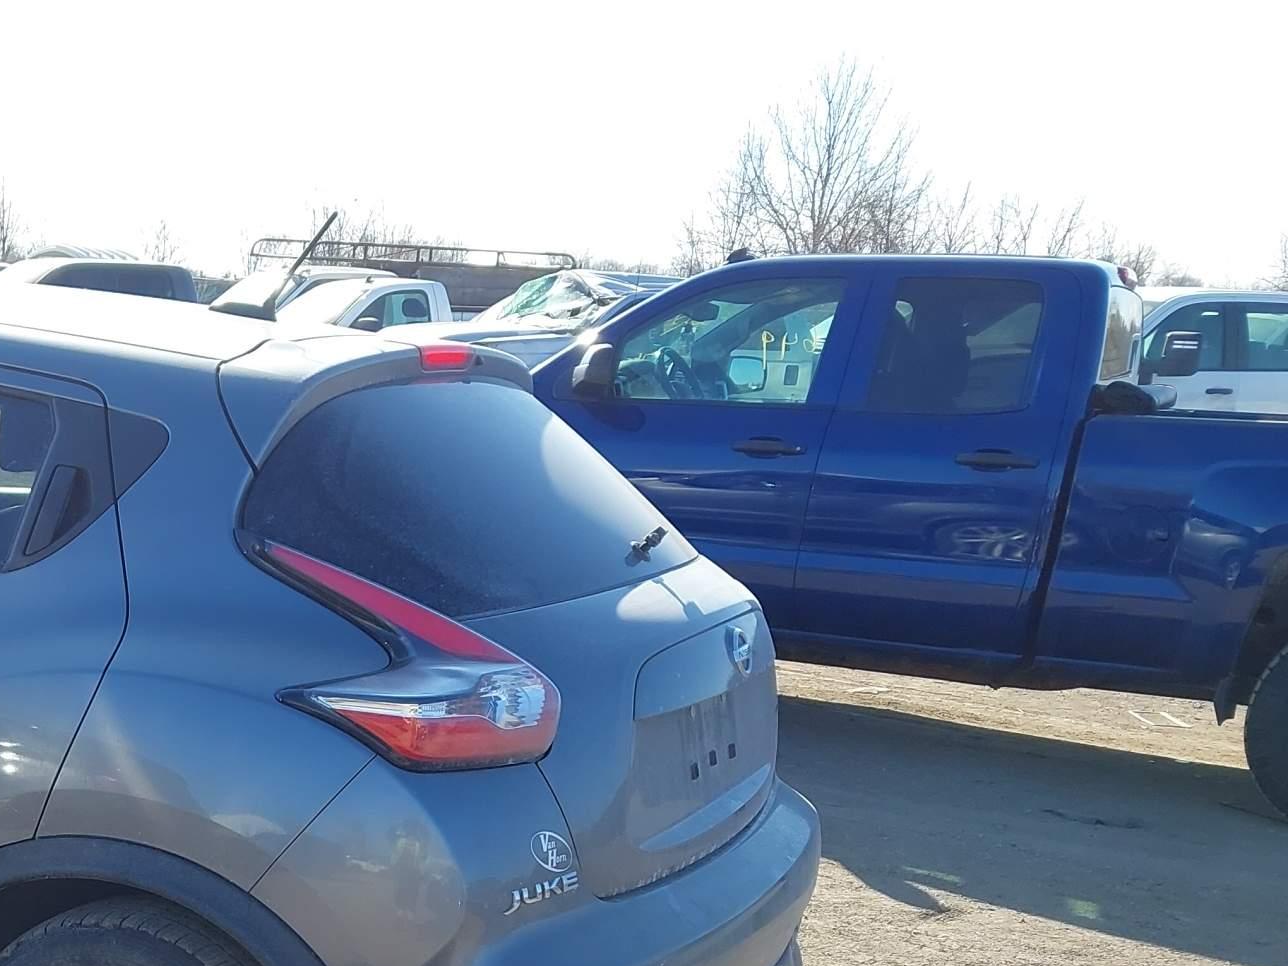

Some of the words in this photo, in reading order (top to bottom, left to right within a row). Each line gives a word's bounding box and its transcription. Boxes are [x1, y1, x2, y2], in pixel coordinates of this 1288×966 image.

[539, 832, 556, 853] Van
[548, 848, 567, 868] Horn
[503, 871, 579, 916] JUKE
